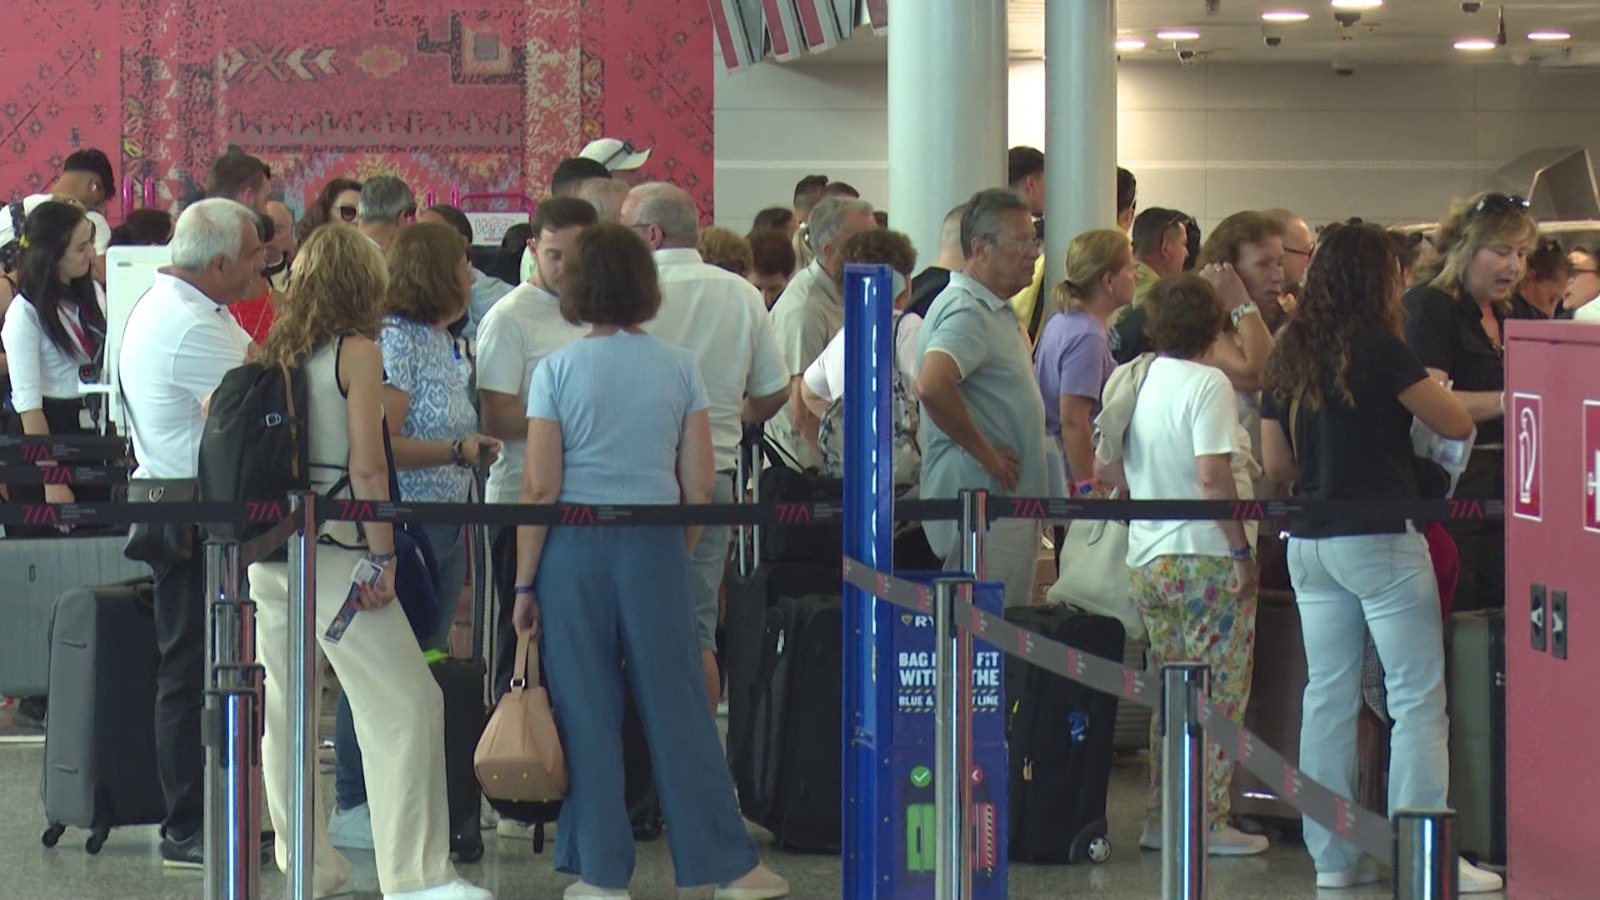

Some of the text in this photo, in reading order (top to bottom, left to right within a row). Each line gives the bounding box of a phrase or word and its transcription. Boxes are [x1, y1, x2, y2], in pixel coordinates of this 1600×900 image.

[899, 652, 929, 667] BAG
[898, 696, 923, 706] BLUE
[978, 696, 999, 706] LINE
